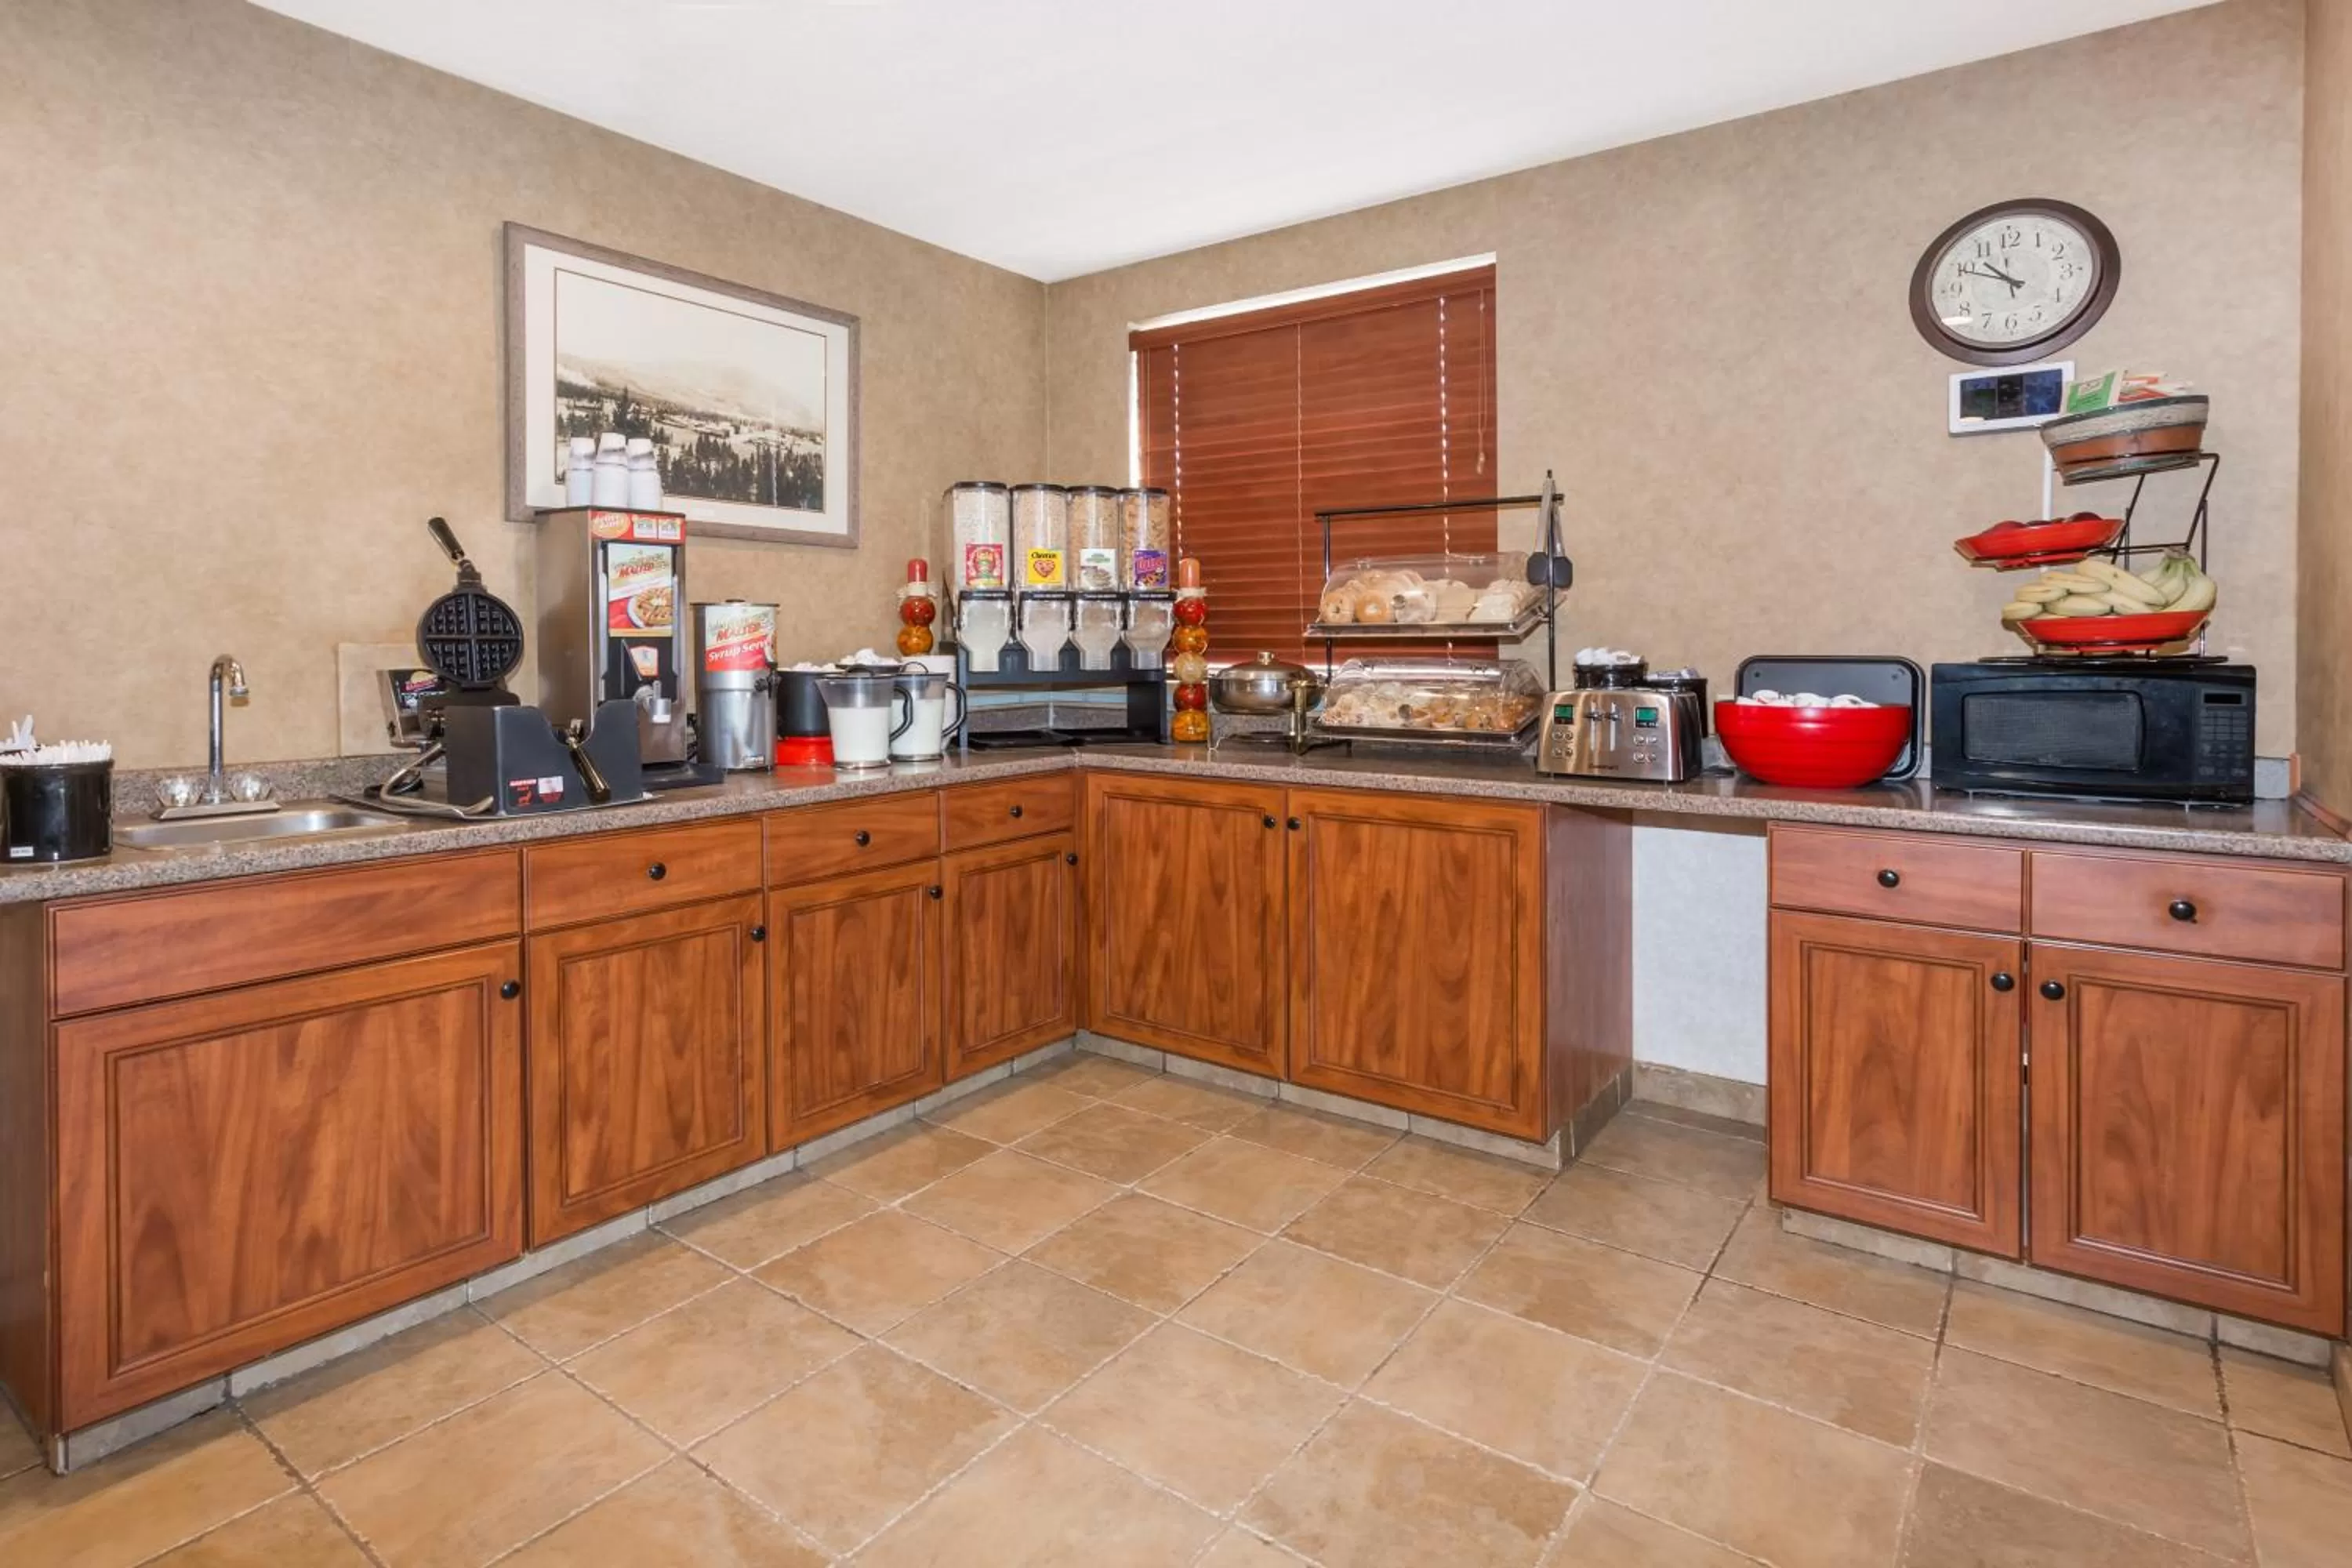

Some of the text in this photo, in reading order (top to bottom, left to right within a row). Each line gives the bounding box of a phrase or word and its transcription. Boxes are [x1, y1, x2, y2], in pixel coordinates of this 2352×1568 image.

[2001, 231, 2020, 249] 12
[2036, 232, 2041, 248] 1
[1977, 241, 1991, 258] 11
[2052, 243, 2064, 260] 2
[2060, 263, 2074, 280] 3
[1950, 281, 1963, 299] 9
[1959, 301, 1970, 318] 8
[2029, 305, 2042, 321] 5
[1981, 313, 1992, 329] 7
[2005, 313, 2018, 330] 6
